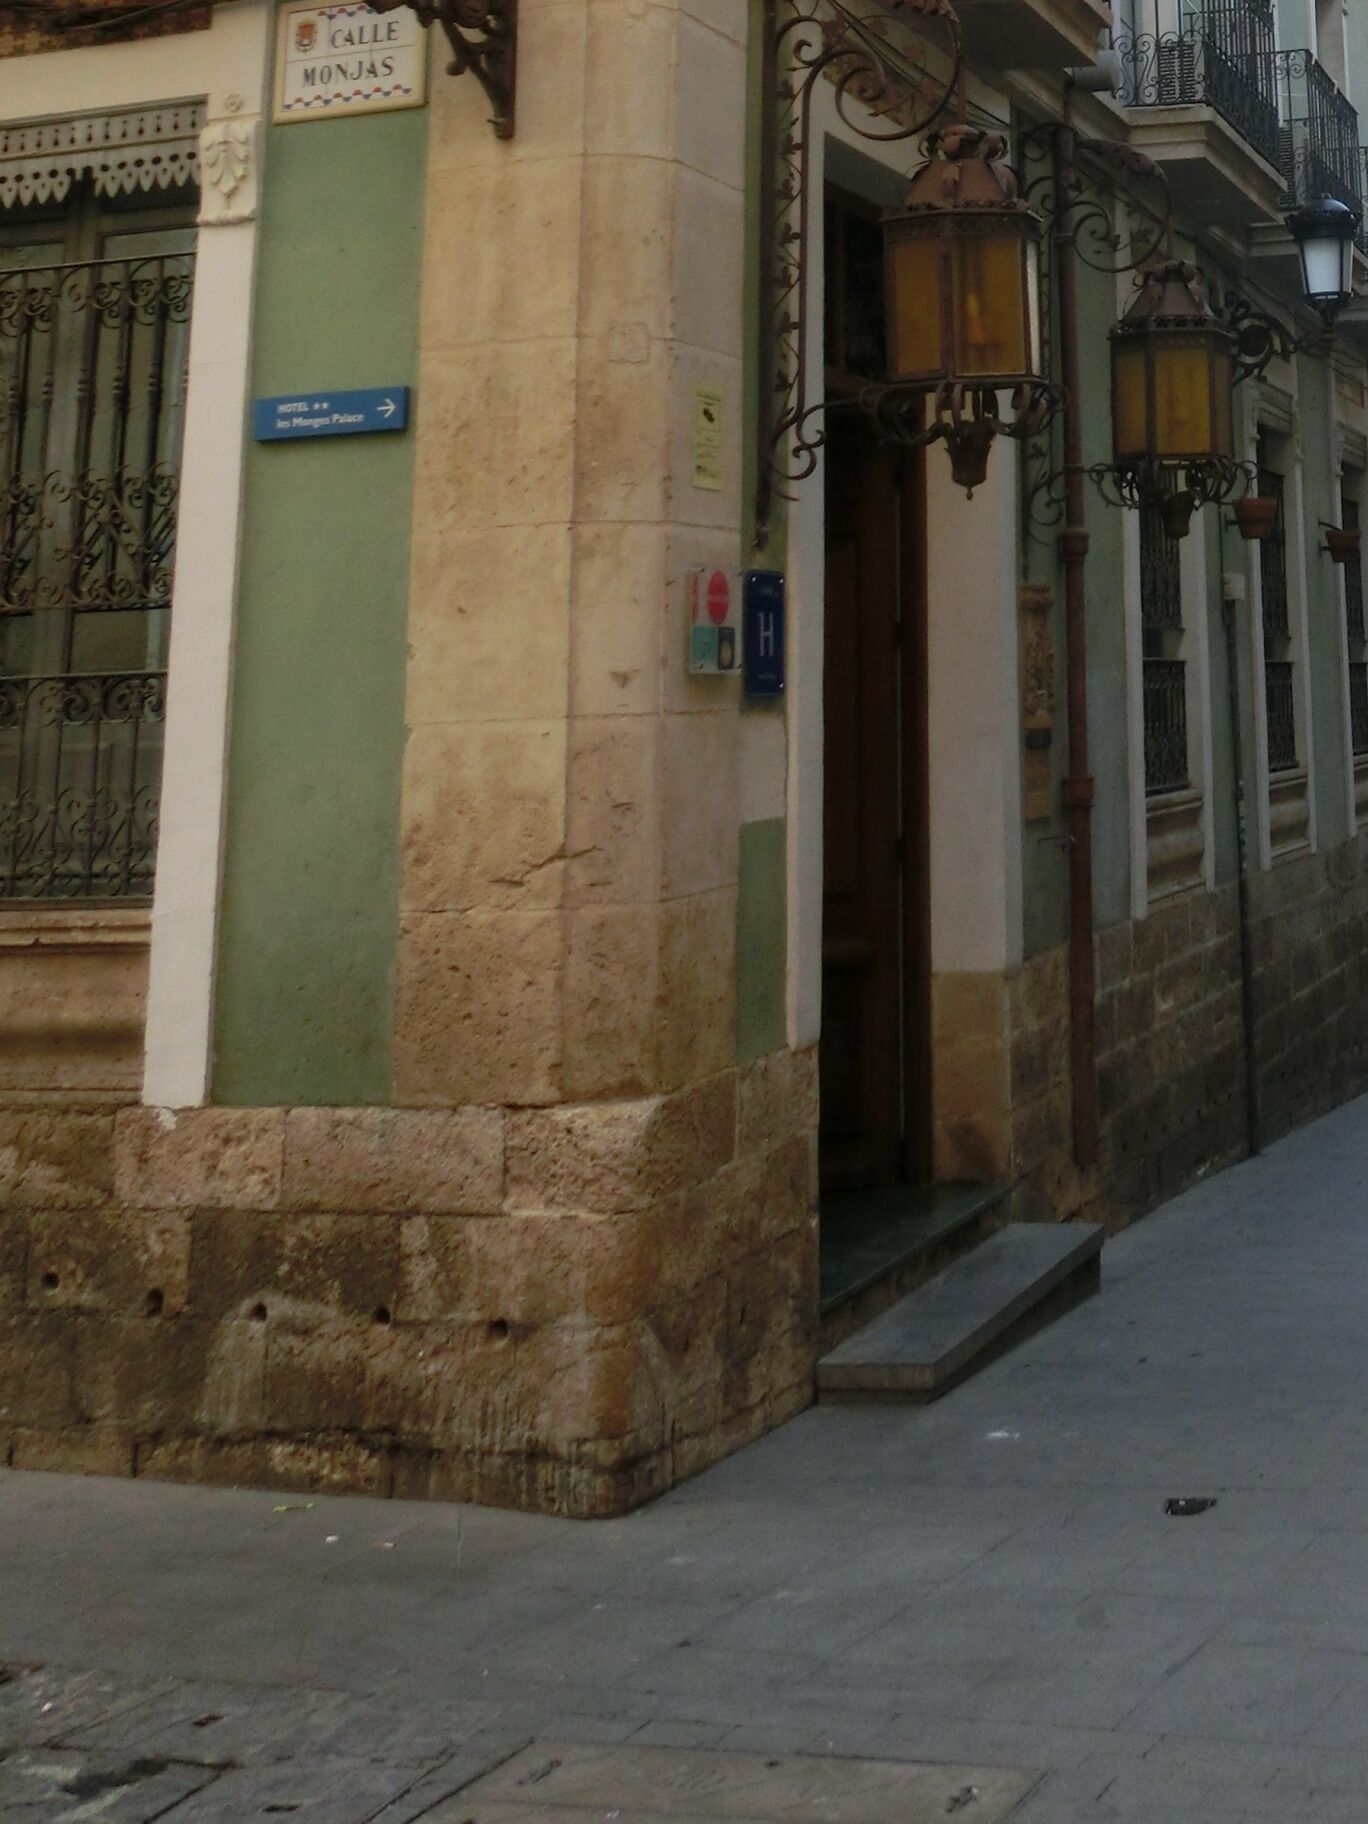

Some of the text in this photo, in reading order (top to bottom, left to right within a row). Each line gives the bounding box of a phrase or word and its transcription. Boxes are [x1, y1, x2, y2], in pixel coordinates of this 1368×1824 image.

[331, 21, 400, 49] CALLE
[302, 56, 395, 88] MONJAS
[277, 402, 309, 413] HOTEL
[332, 413, 364, 424] Palace
[759, 611, 774, 657] H
